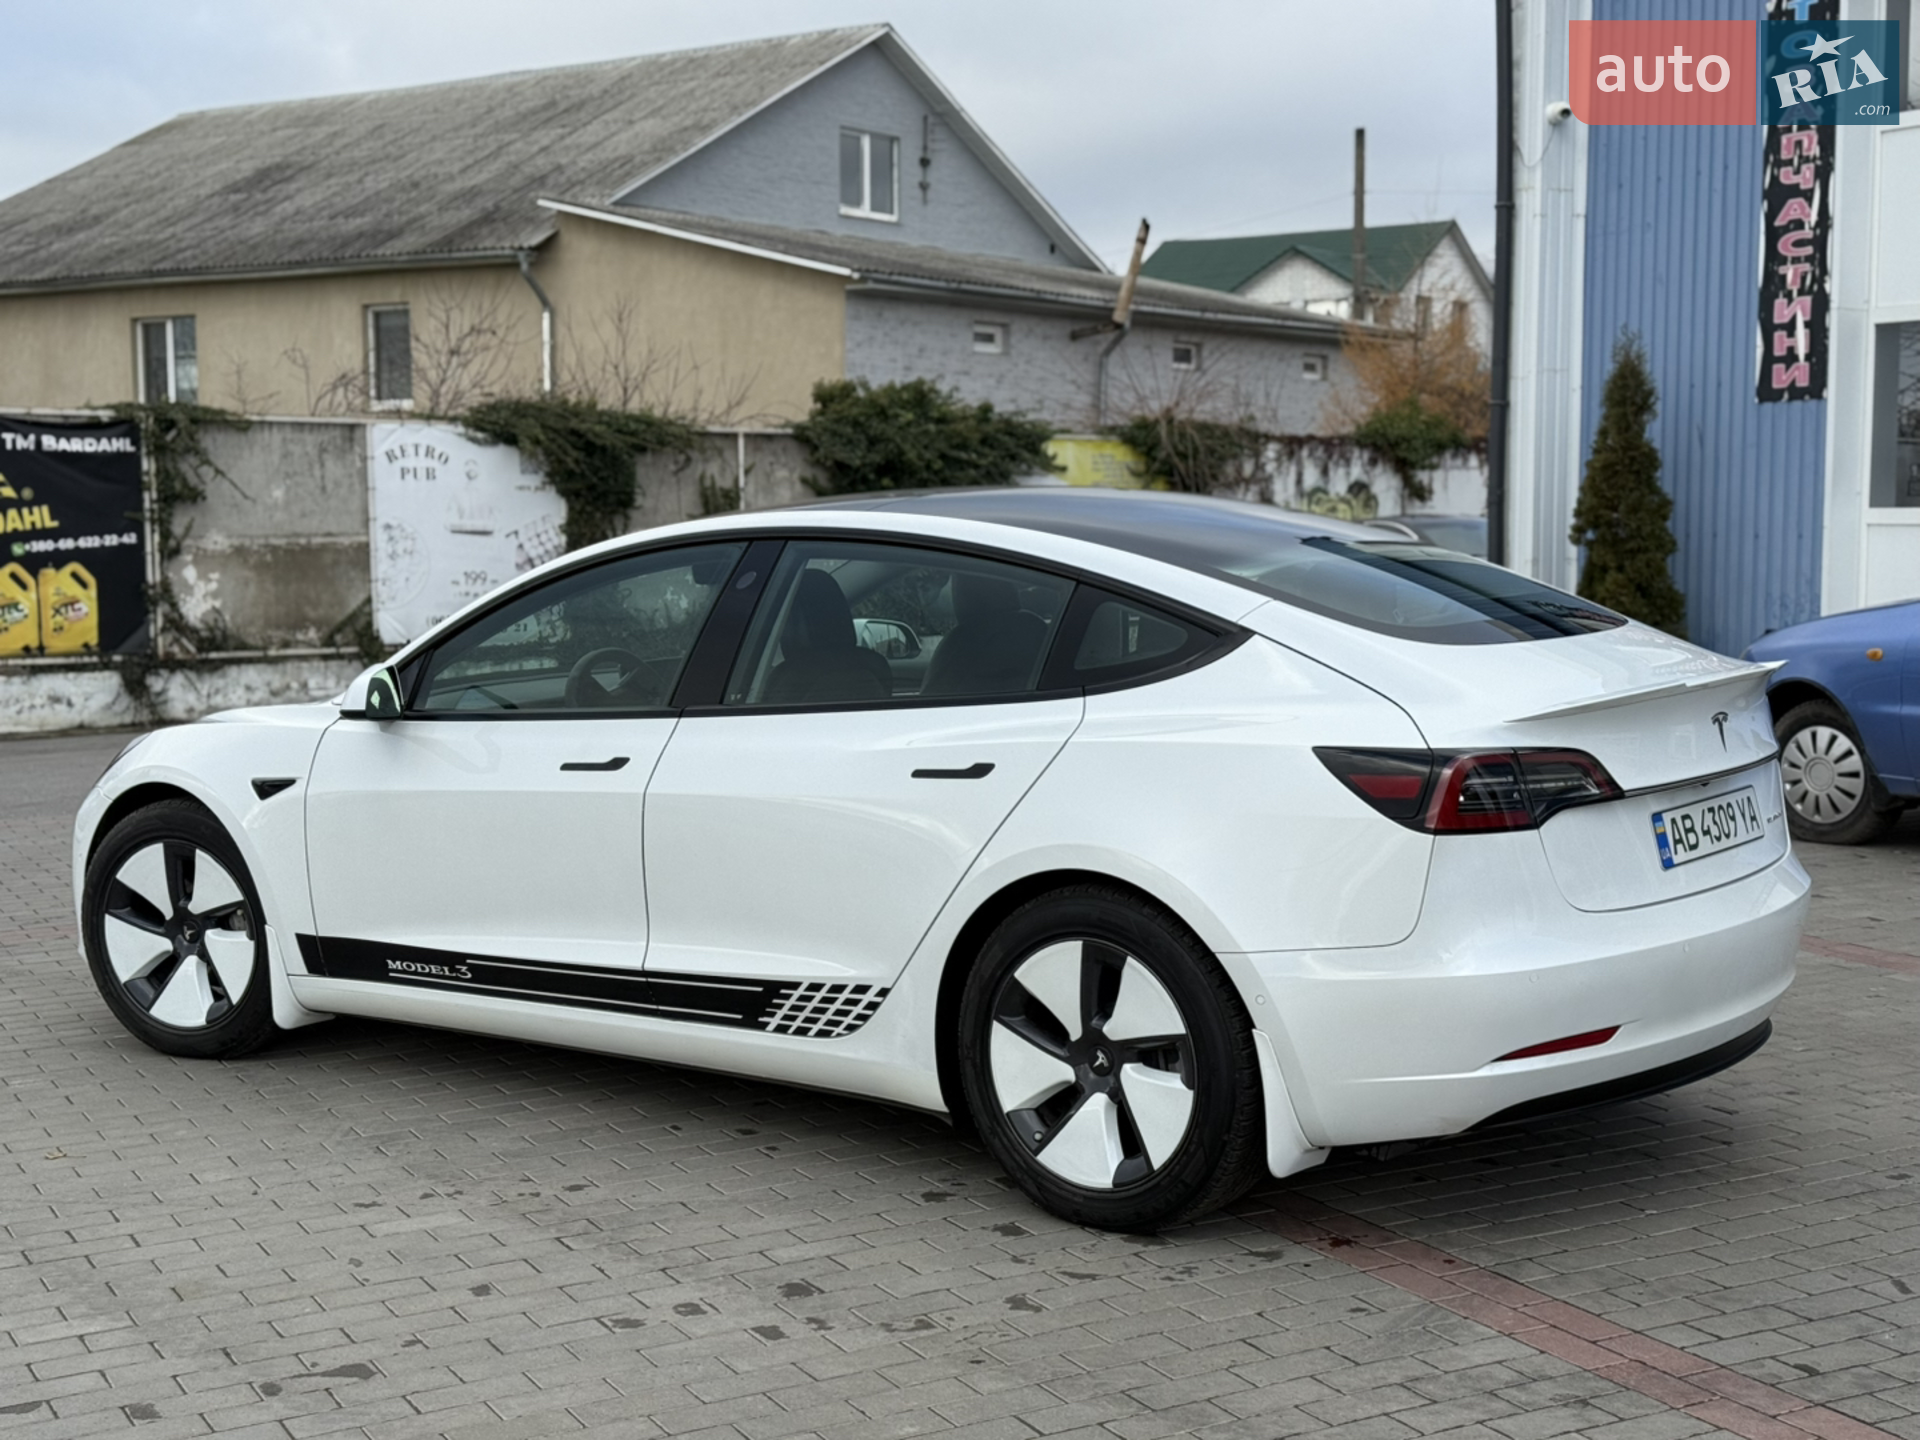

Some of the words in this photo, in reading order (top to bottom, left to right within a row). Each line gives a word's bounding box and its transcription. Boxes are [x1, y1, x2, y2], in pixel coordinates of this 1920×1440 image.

[1, 432, 36, 451] TM
[384, 443, 450, 465] RETRO
[400, 466, 437, 481] PUB
[464, 570, 488, 586] 199
[1670, 813, 1699, 855] AB
[1701, 802, 1738, 845] 4309
[1735, 795, 1760, 834] YA
